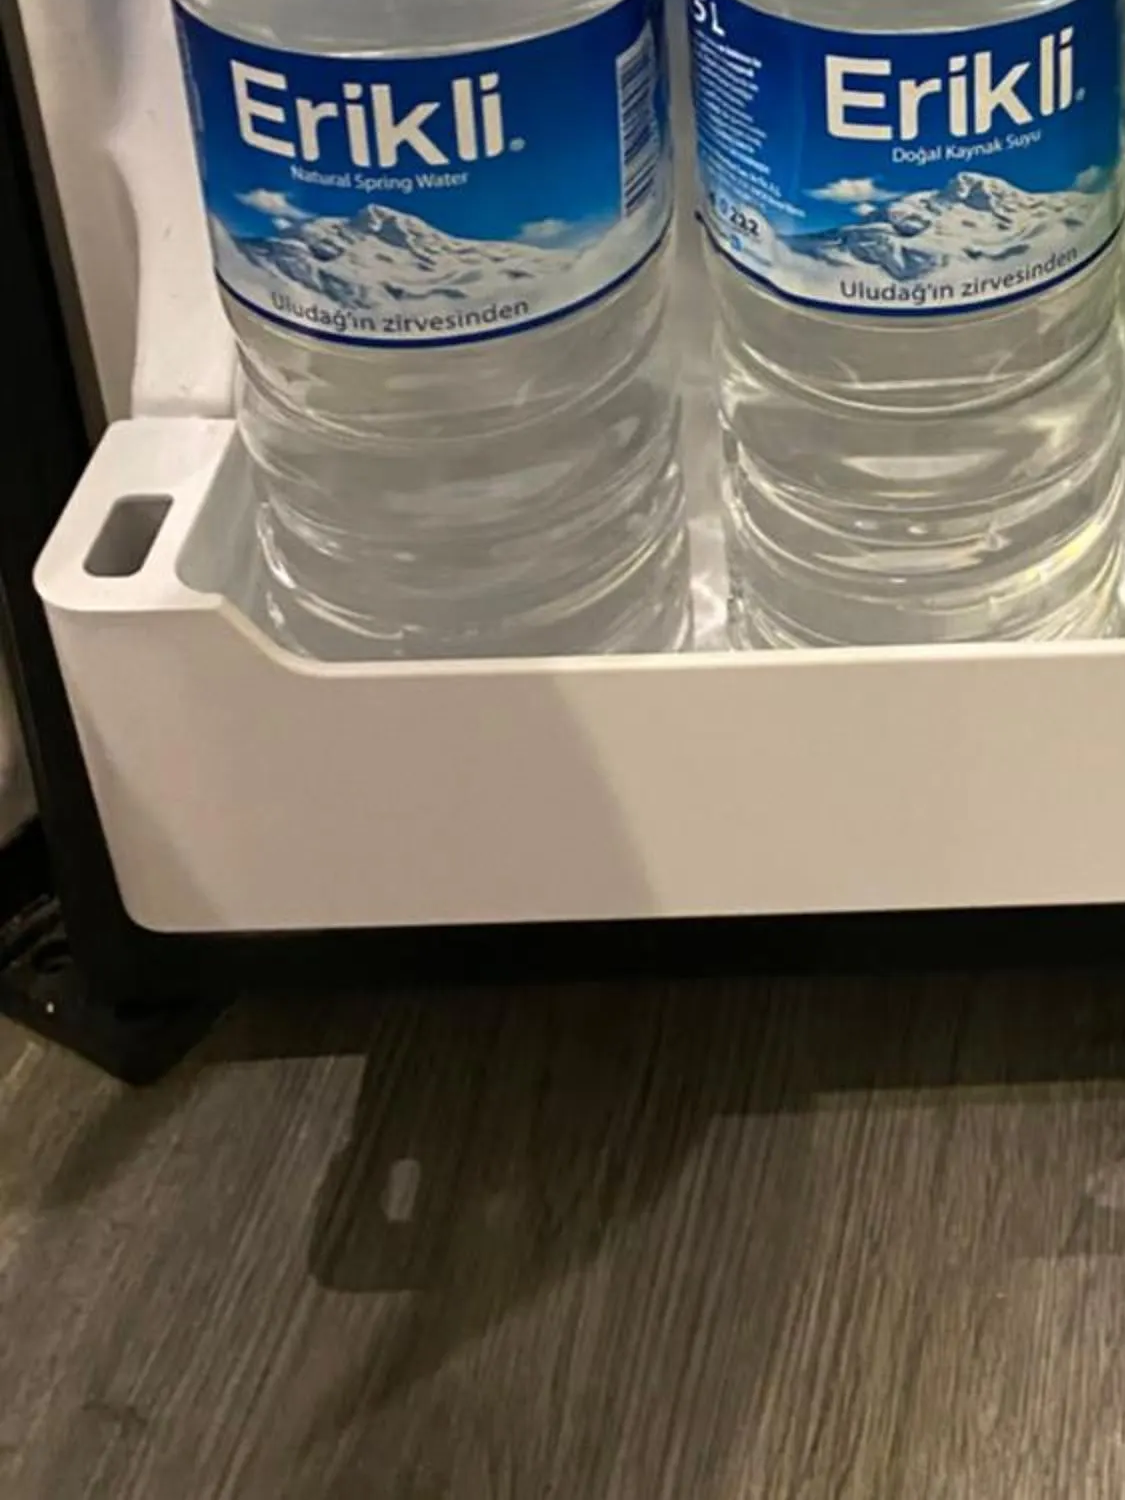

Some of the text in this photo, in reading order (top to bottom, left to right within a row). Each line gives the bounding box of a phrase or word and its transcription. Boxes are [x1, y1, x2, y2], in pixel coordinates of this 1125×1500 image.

[824, 27, 1075, 141] Erikli
[230, 59, 506, 169] Erikli
[892, 129, 1042, 166] Doğal Kaynak Suyu
[291, 166, 470, 194] Natural Spring Water
[839, 246, 1079, 304] Uludağ'ın zirvesinden
[271, 291, 530, 333] Uludağ'ın zirvesinden
